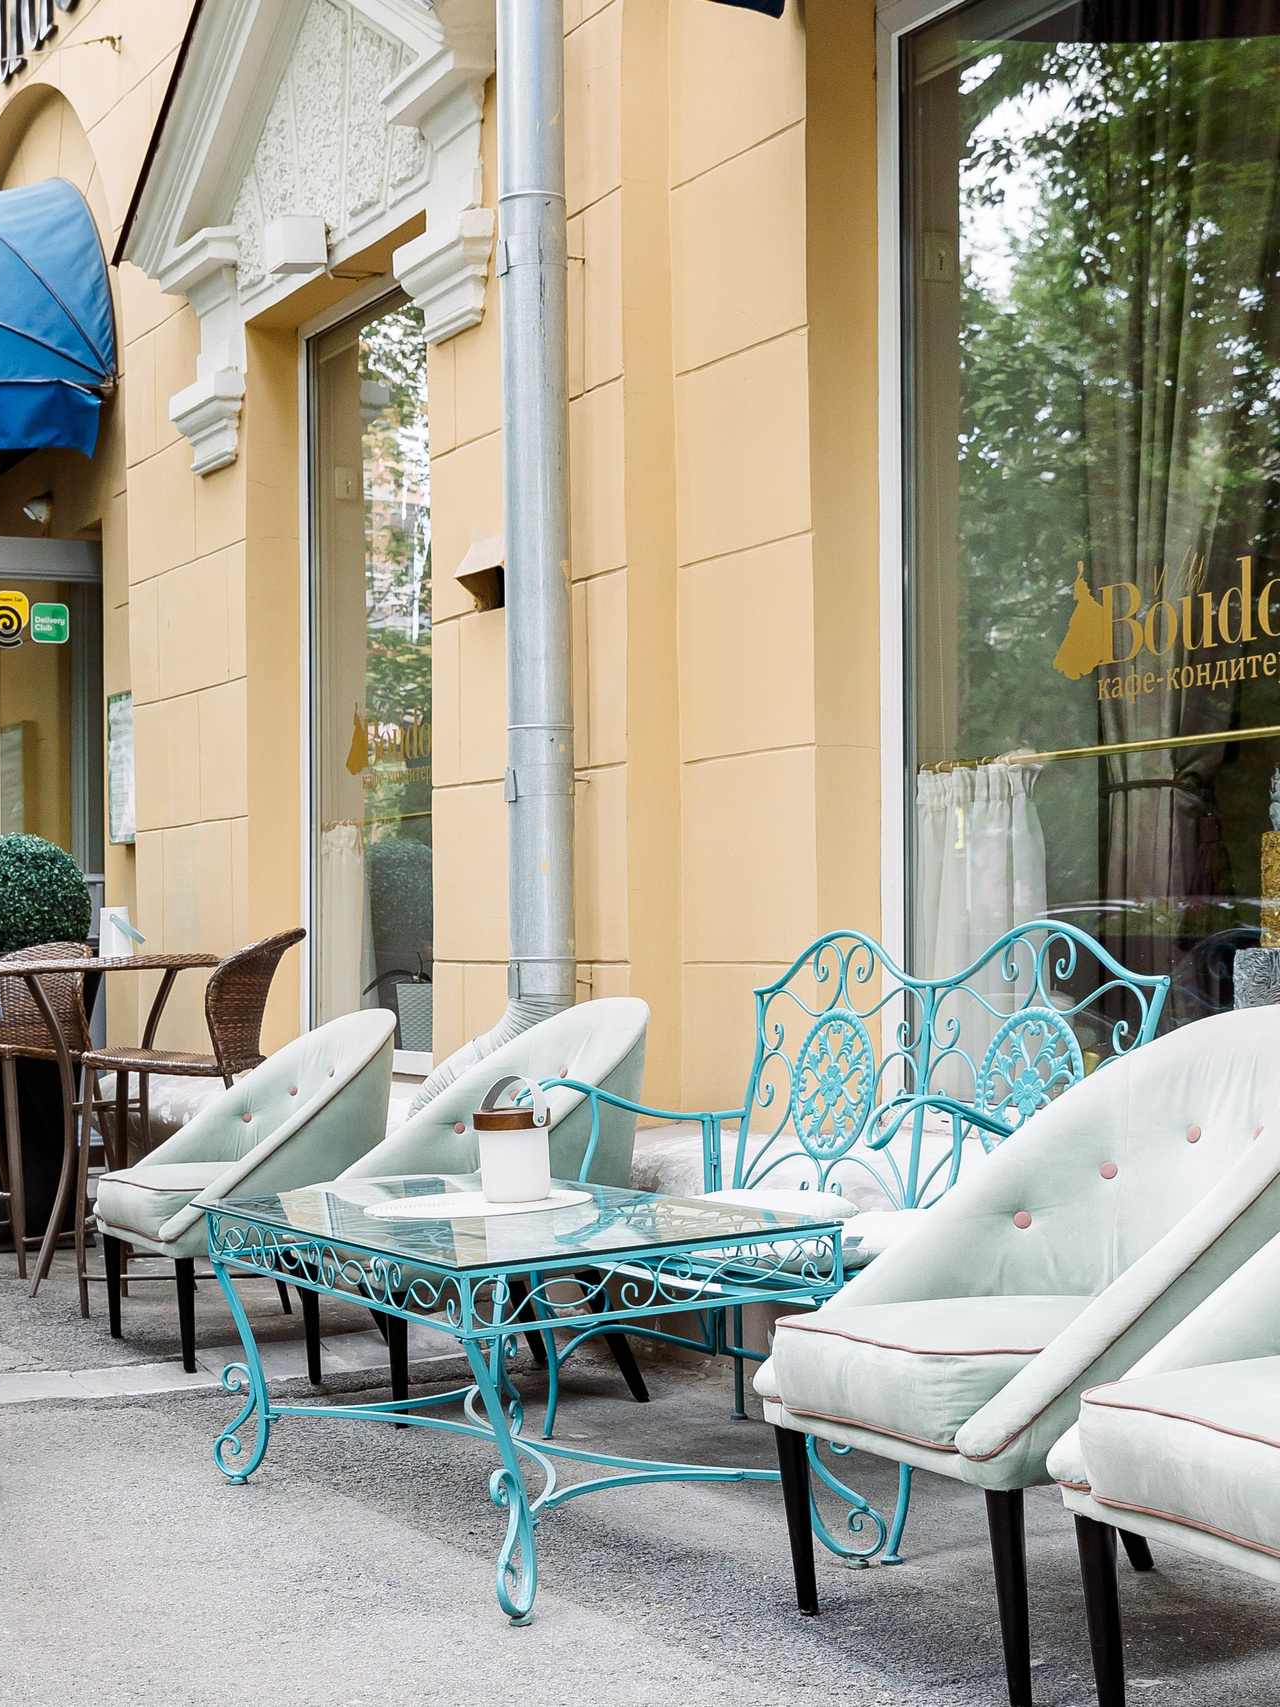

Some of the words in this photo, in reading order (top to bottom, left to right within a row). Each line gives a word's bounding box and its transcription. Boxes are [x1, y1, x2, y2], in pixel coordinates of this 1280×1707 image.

[34, 616, 66, 626] Delivery
[34, 623, 53, 631] Club
[1097, 650, 1280, 706] кафе-кондите
